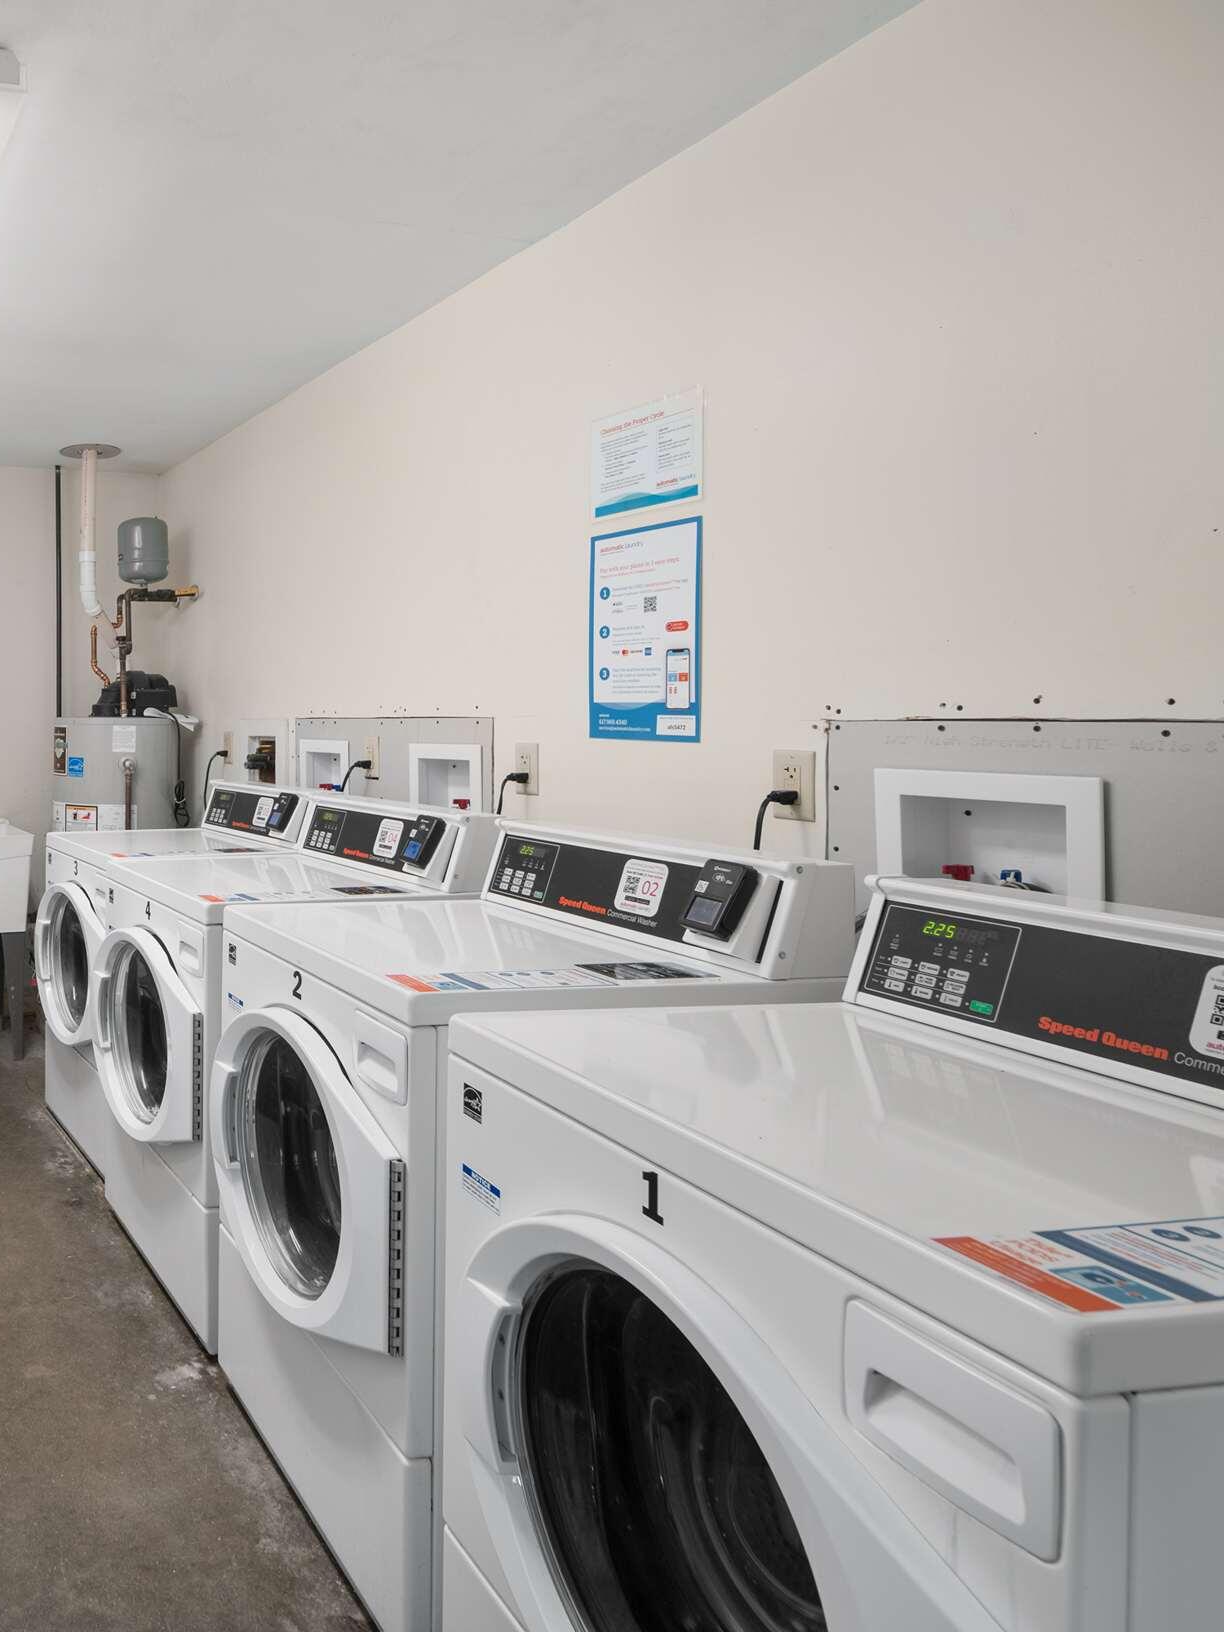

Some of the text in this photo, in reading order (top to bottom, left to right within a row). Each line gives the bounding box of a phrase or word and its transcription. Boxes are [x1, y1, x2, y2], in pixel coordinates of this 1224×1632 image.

[641, 880, 659, 897] 02
[558, 896, 582, 908] Speed
[582, 901, 606, 916] Queen
[292, 970, 303, 1001] 2
[1038, 1016, 1100, 1043] Speed
[1102, 1031, 1169, 1061] Queen
[642, 1171, 664, 1227] 1
